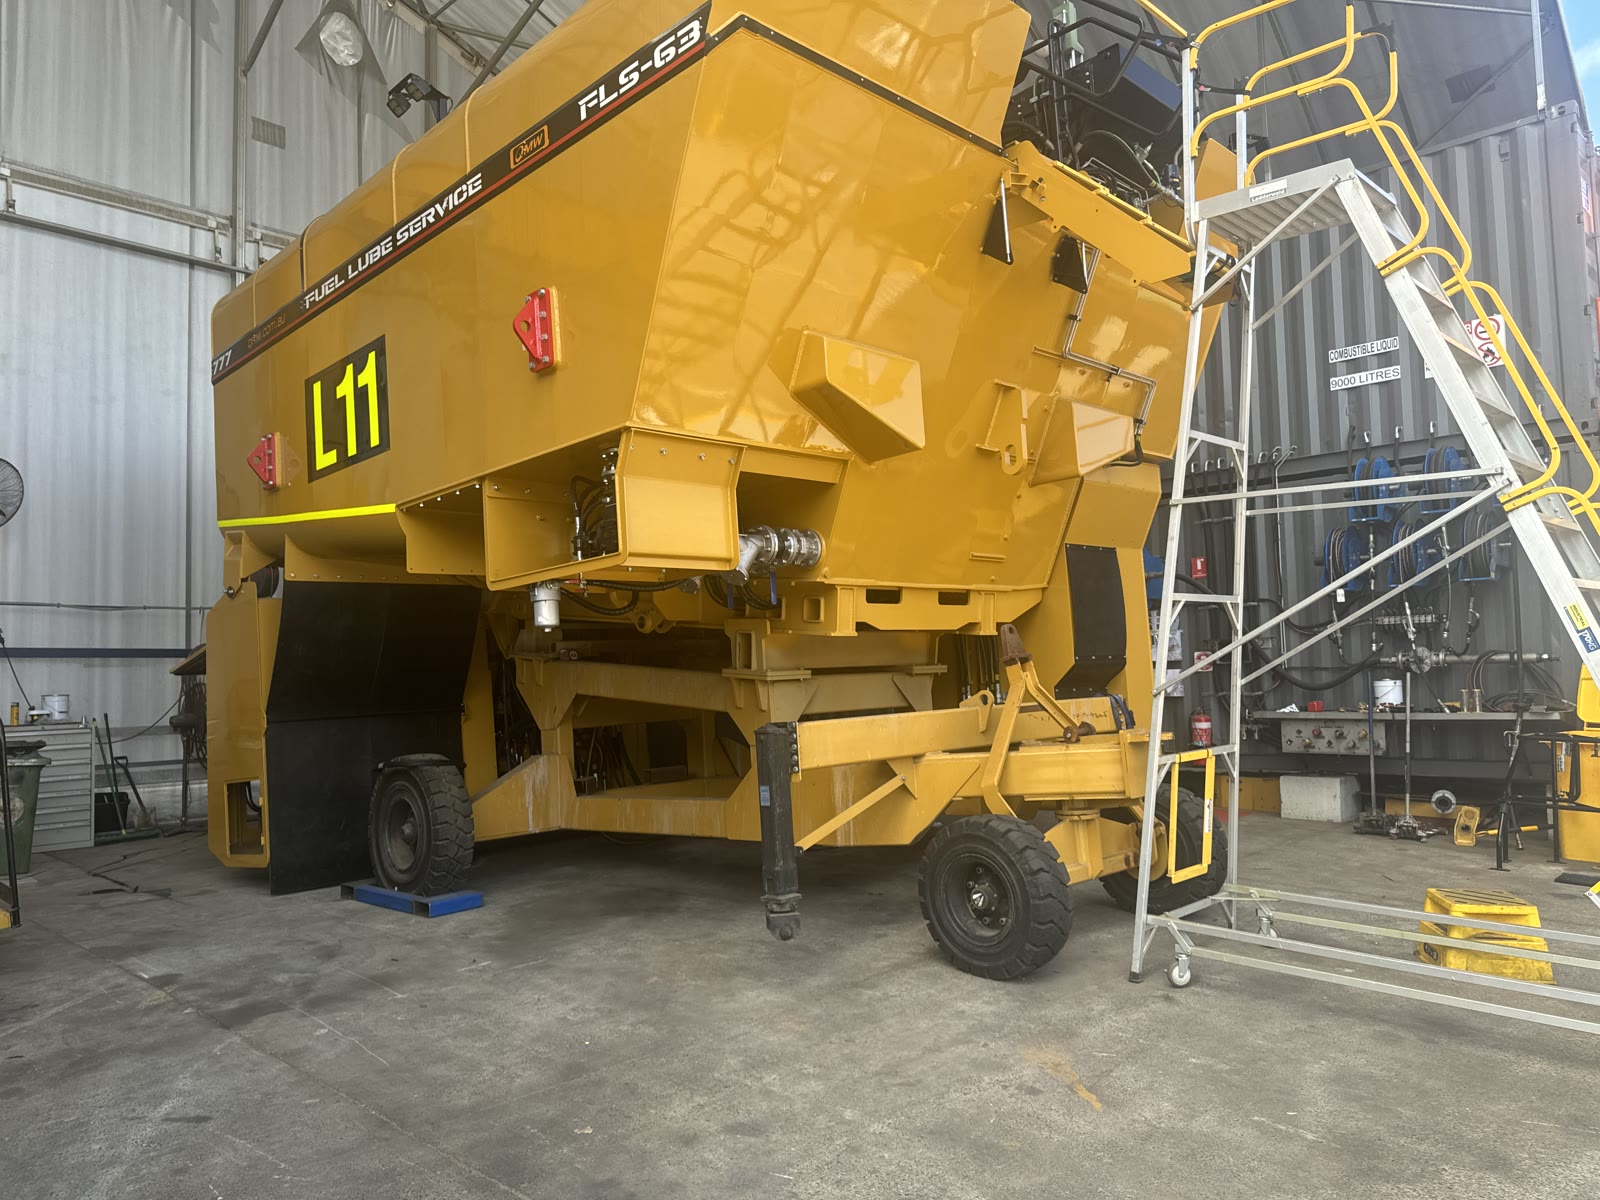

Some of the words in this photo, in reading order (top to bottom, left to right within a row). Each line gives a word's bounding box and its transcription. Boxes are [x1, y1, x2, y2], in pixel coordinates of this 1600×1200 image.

[578, 19, 701, 121] FLS-63
[515, 132, 544, 163] QMW
[304, 273, 345, 309] FUEL
[348, 236, 393, 279] LUBE
[396, 172, 482, 246] SERVICE
[212, 349, 232, 376] 777
[1330, 342, 1375, 361] COMBUSTIBLE
[1376, 338, 1398, 351] LIQUID
[1331, 376, 1356, 389] 9000
[1359, 368, 1400, 384] LITRES
[313, 350, 380, 471] L11
